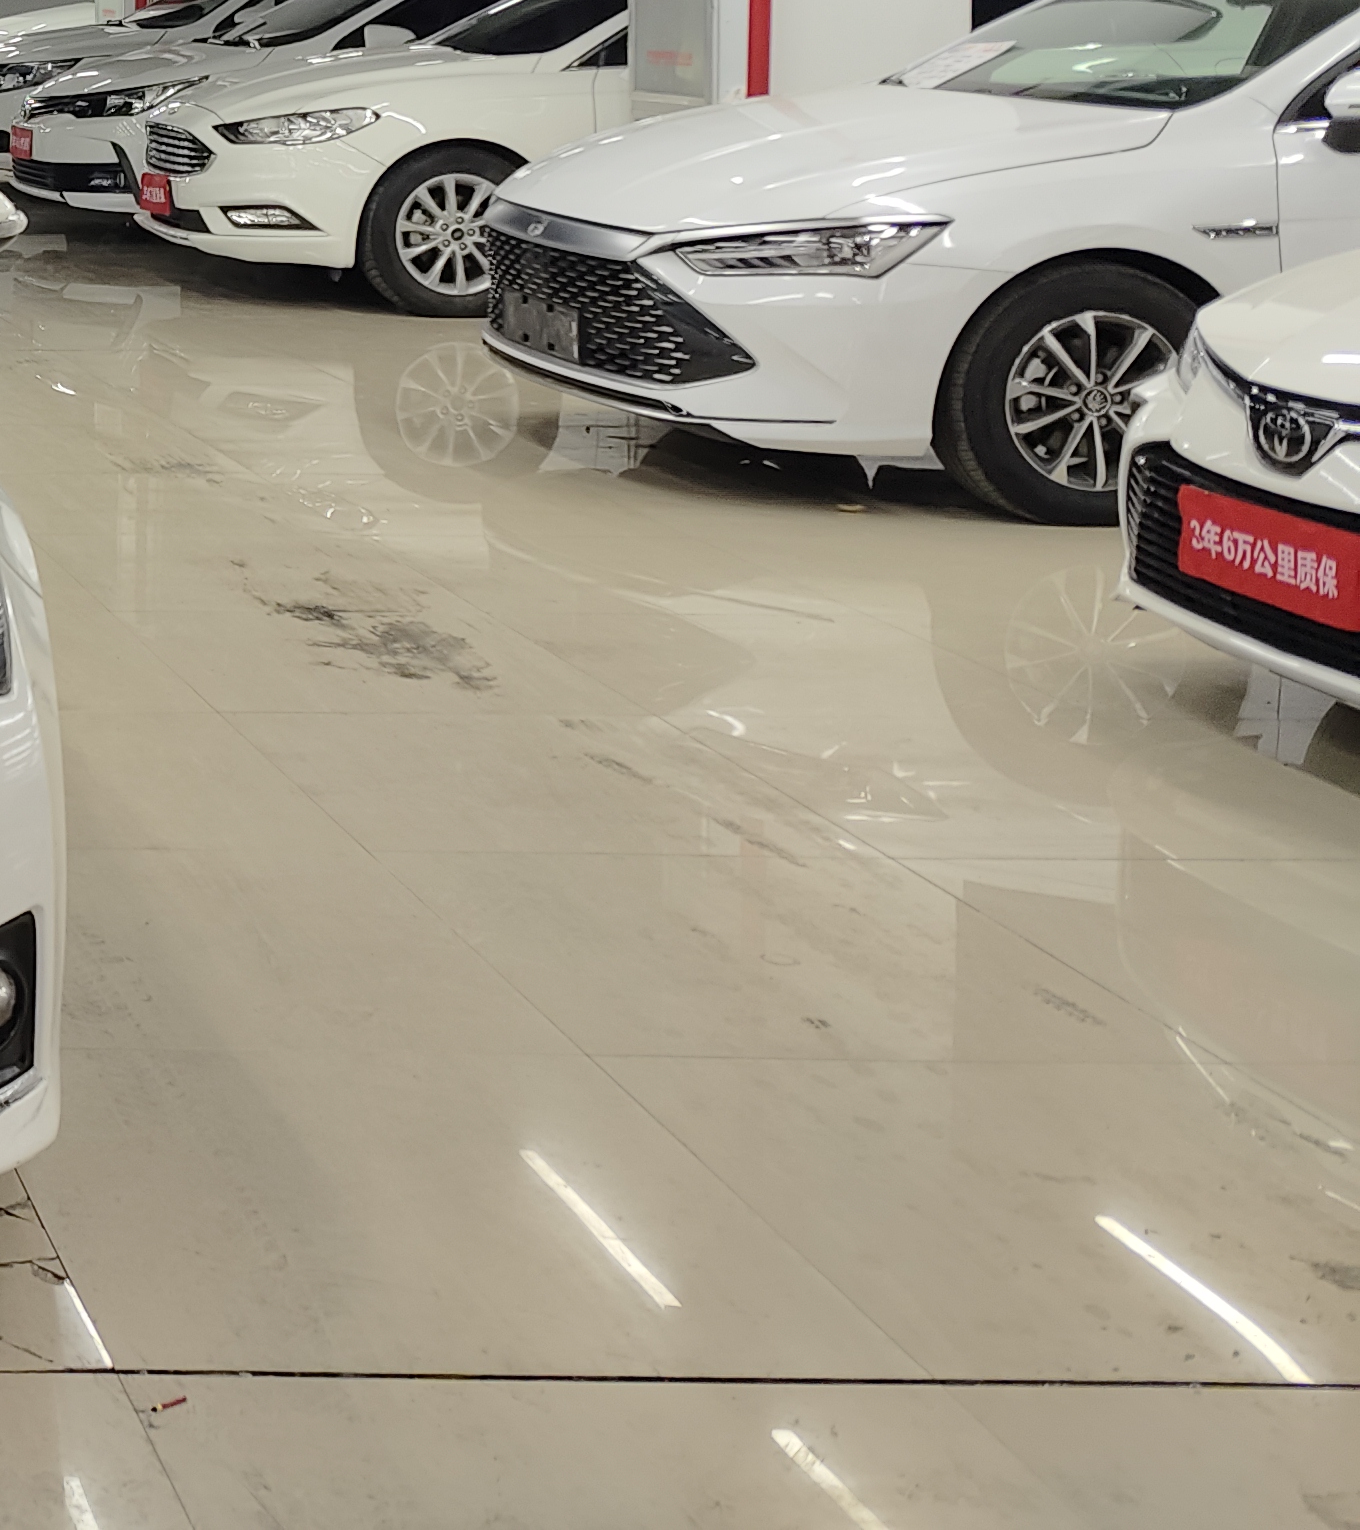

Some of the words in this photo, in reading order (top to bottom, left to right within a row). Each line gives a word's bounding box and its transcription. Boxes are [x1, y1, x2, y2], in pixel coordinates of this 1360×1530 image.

[1189, 519, 1339, 599] 3年6万公里质保
